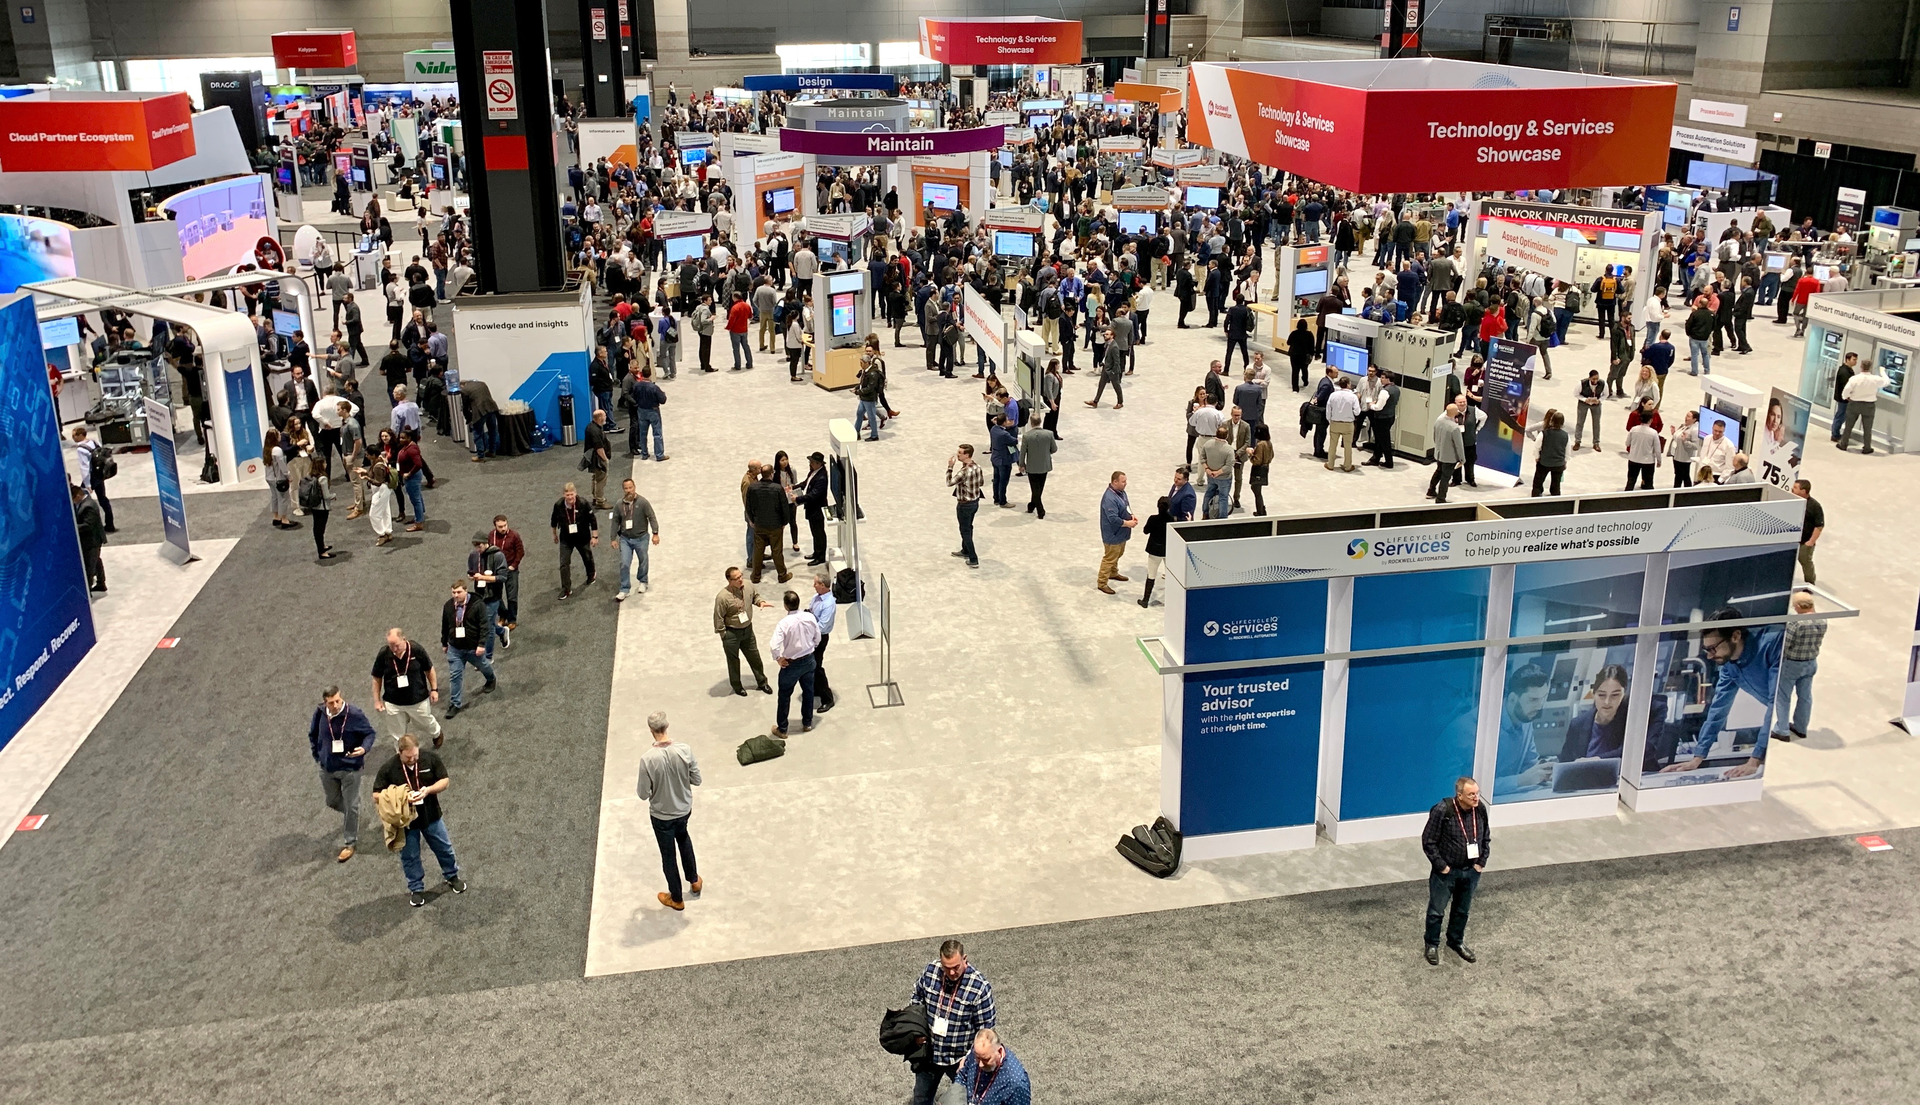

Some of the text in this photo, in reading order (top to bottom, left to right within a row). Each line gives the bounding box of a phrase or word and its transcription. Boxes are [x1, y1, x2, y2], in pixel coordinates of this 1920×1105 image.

[976, 35, 1016, 44] Technology
[997, 46, 1034, 54] Showcase
[798, 77, 833, 88] Design
[828, 108, 885, 118] Maintain
[1258, 102, 1334, 133] Technology & Services
[1700, 107, 1735, 118] Process Solutions
[9, 132, 134, 144] Cloud Partner Ecosystem
[1428, 118, 1614, 141] Technology & Services
[868, 136, 934, 152] Maintain
[1275, 129, 1310, 152] Showcase
[1676, 130, 1746, 149] Process Automation Solutions
[1476, 146, 1561, 163] Showcase
[1816, 147, 1830, 156] EXIT
[1488, 207, 1638, 229] NETWORK INFRASTRUCTURE
[1502, 231, 1558, 257] Asset Optimization
[1506, 246, 1550, 268] and Workforce
[470, 320, 569, 331] Knowledge and insights
[1814, 302, 1915, 337] Smart manufacturing solutions
[1762, 460, 1790, 491] 75%
[1466, 520, 1653, 542] Combining expertise and technology
[1373, 540, 1450, 557] Services
[1465, 536, 1640, 557] to help you realize what's possible
[1222, 622, 1278, 635] Services
[15, 647, 50, 691] Respond.
[50, 617, 80, 654] Recover.
[1202, 678, 1289, 697] Your trusted
[1201, 697, 1254, 712] advisor
[1201, 709, 1296, 724] with the right expertise
[1225, 723, 1246, 733] right
[1247, 722, 1268, 730] time.
